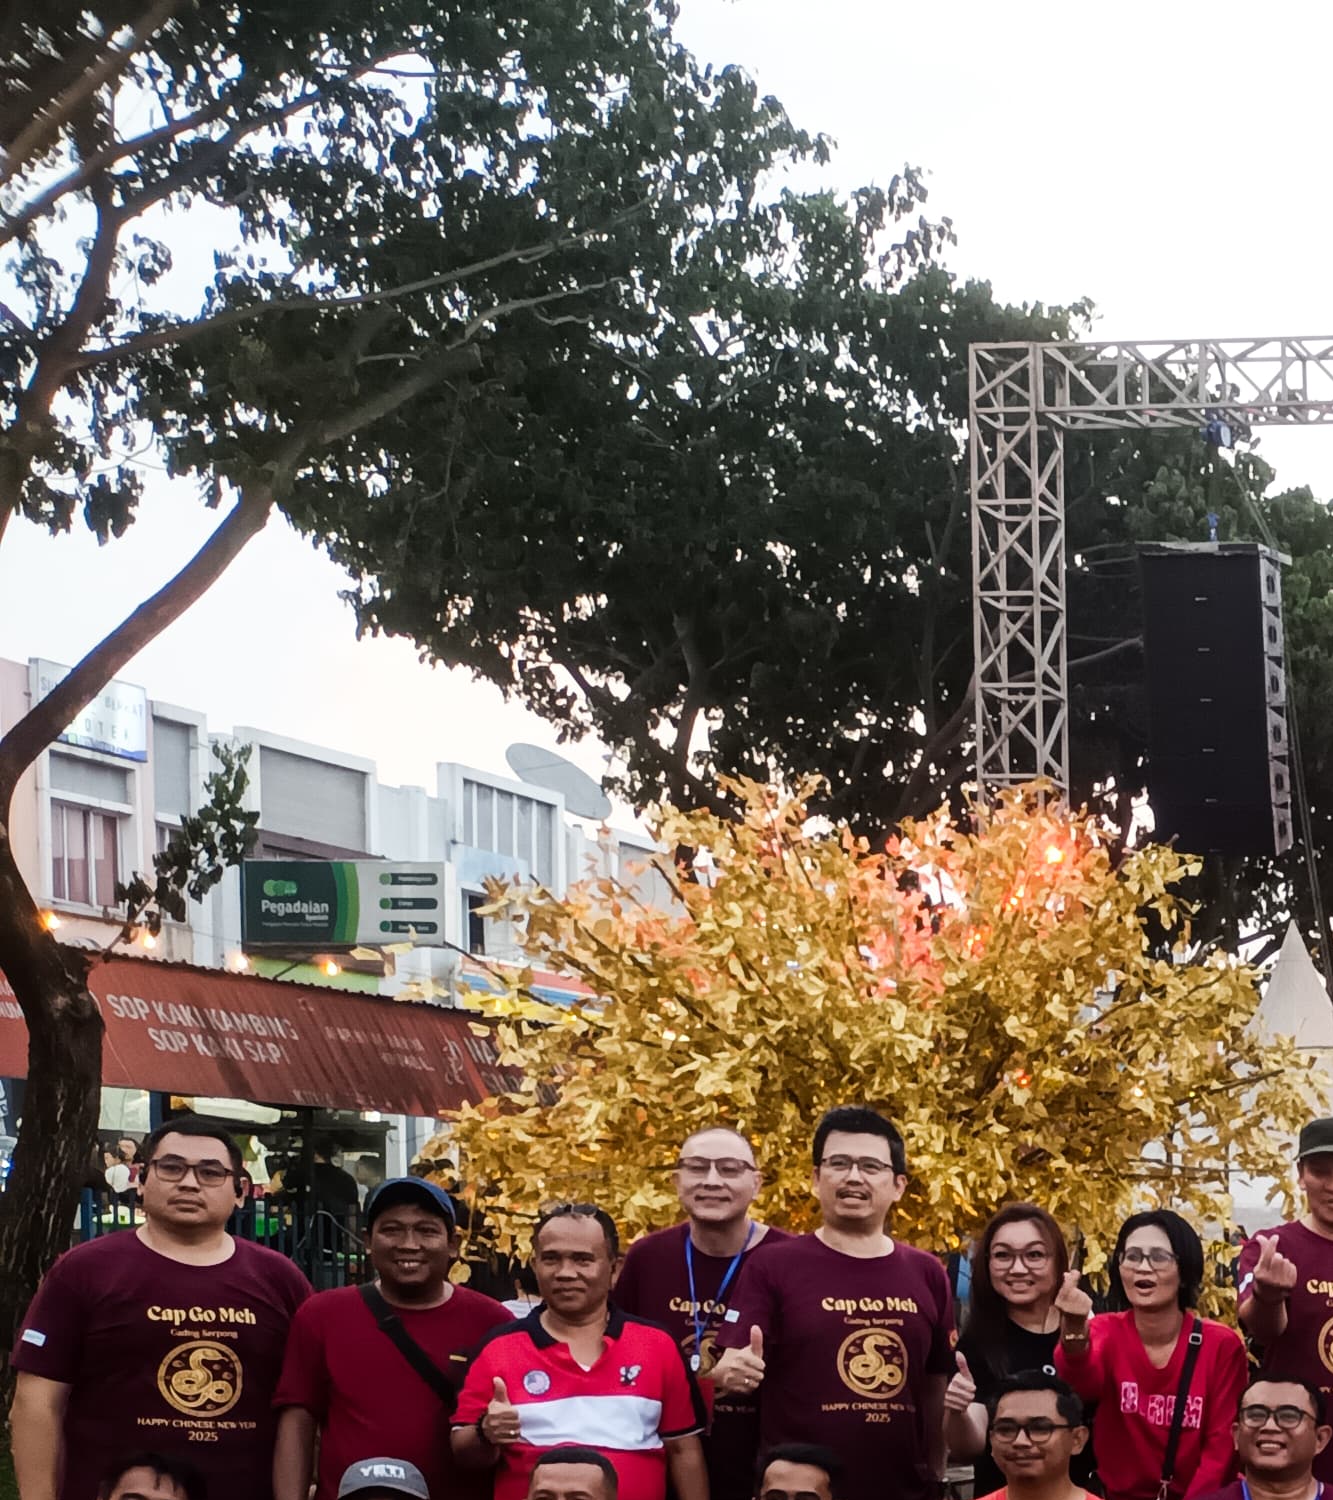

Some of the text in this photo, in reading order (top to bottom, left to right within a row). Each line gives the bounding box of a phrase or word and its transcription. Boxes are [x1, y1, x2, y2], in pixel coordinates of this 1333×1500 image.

[261, 900, 329, 917] Pegadaian
[106, 994, 150, 1021] SOP
[151, 1000, 205, 1028] KAKI
[203, 1007, 299, 1041] KAMBING
[148, 1027, 291, 1065] SOP KAKI SAPI
[822, 1297, 918, 1315] Cap Go Meh
[147, 1305, 256, 1326] Cap Go Meh
[137, 1417, 169, 1426] HAPPY
[172, 1419, 215, 1428] CHINESE
[865, 1413, 892, 1424] 2025
[187, 1431, 218, 1442] 2025
[360, 1464, 406, 1479] YETI
